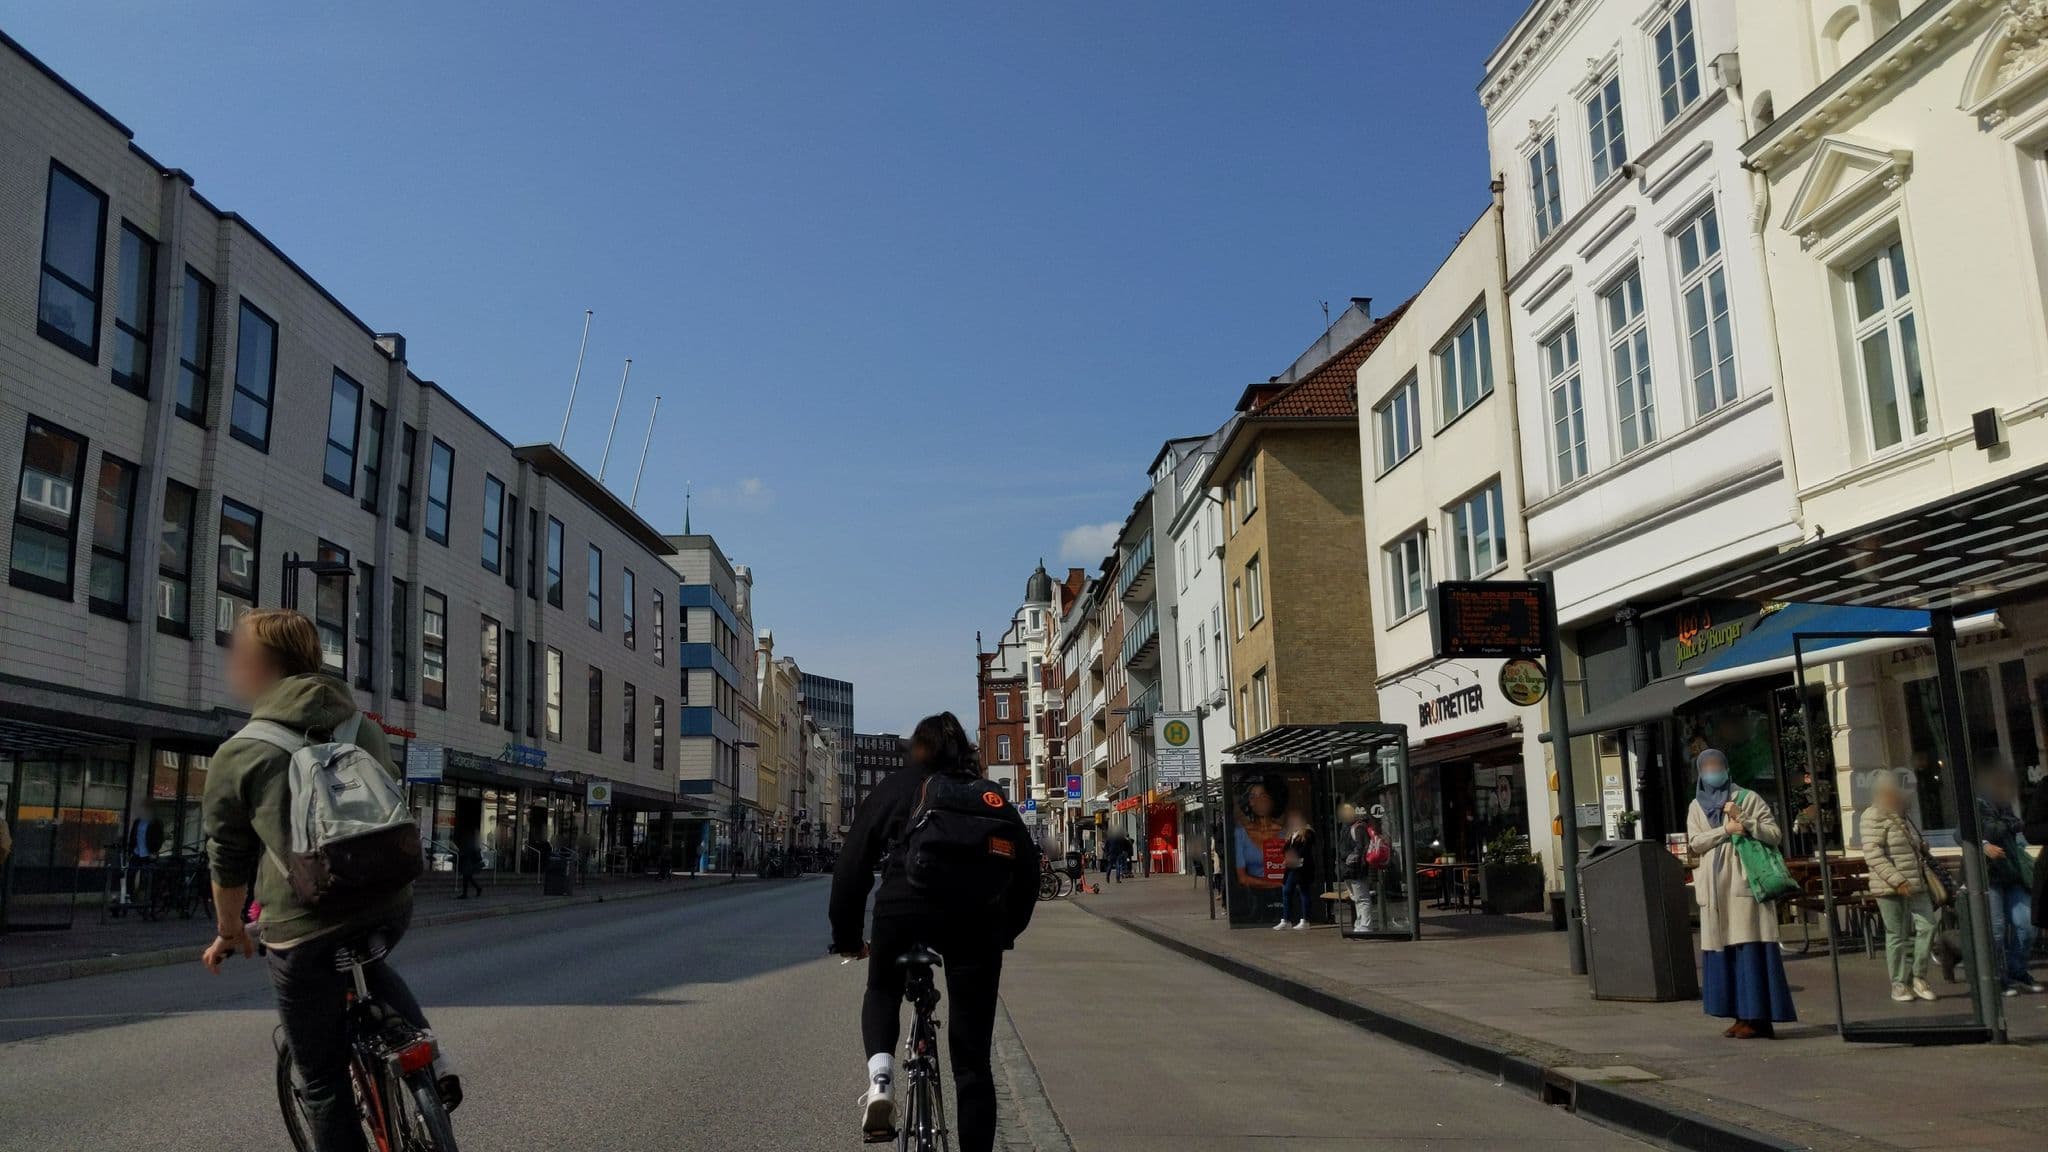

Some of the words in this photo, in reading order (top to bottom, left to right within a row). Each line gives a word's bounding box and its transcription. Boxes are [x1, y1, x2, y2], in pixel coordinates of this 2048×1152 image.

[1707, 621, 1744, 648] Burger
[1418, 684, 1485, 727] BROTRETTER
[1170, 726, 1183, 741] H
[1266, 860, 1287, 870] Pars
